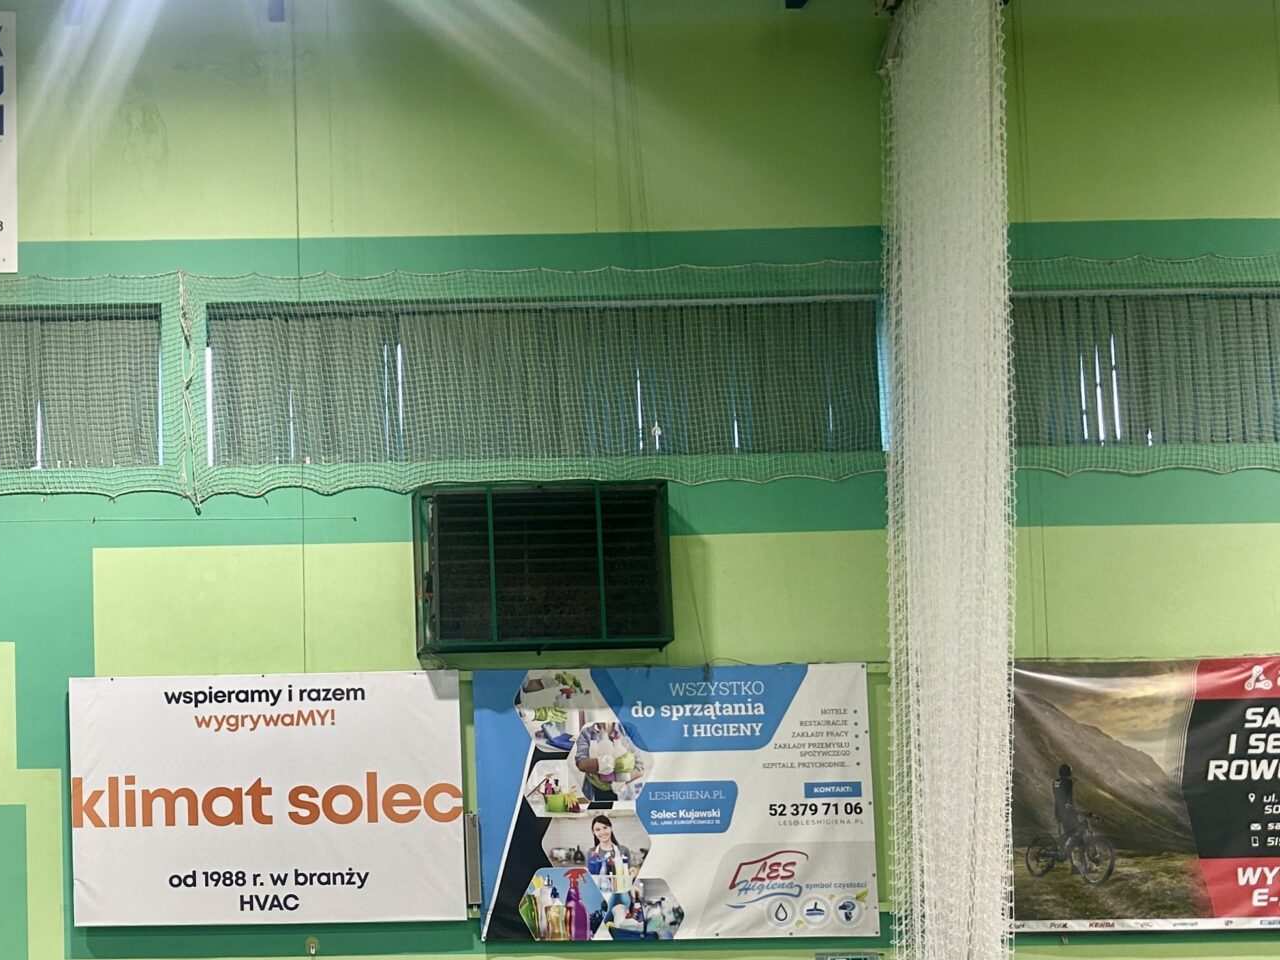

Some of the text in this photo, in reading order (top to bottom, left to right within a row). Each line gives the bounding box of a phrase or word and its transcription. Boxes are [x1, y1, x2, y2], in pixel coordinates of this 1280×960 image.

[164, 685, 365, 708] wspieramy i razem
[669, 680, 765, 697] WSZYSTKO
[631, 699, 765, 721] do sprzątania
[194, 709, 336, 733] wygrywaMY!
[799, 719, 848, 727] RESTAURACJE
[683, 723, 763, 737] I HIGIENY
[1228, 733, 1237, 755] I
[1207, 759, 1280, 781] ROW
[72, 771, 464, 828] klimat solec
[648, 790, 726, 801] LESHIGIENA.PL
[1263, 793, 1279, 803] ul.
[650, 808, 721, 820] Solec Kujawski
[769, 802, 863, 817] 52 379 71 06
[778, 818, 865, 827] LES@LESHIGIENA.PL
[169, 867, 370, 890] od 1988 r. w branży
[751, 861, 797, 882] LES
[735, 879, 796, 896] Higiena
[806, 881, 867, 889] symbol czystości
[239, 893, 300, 912] HVAC
